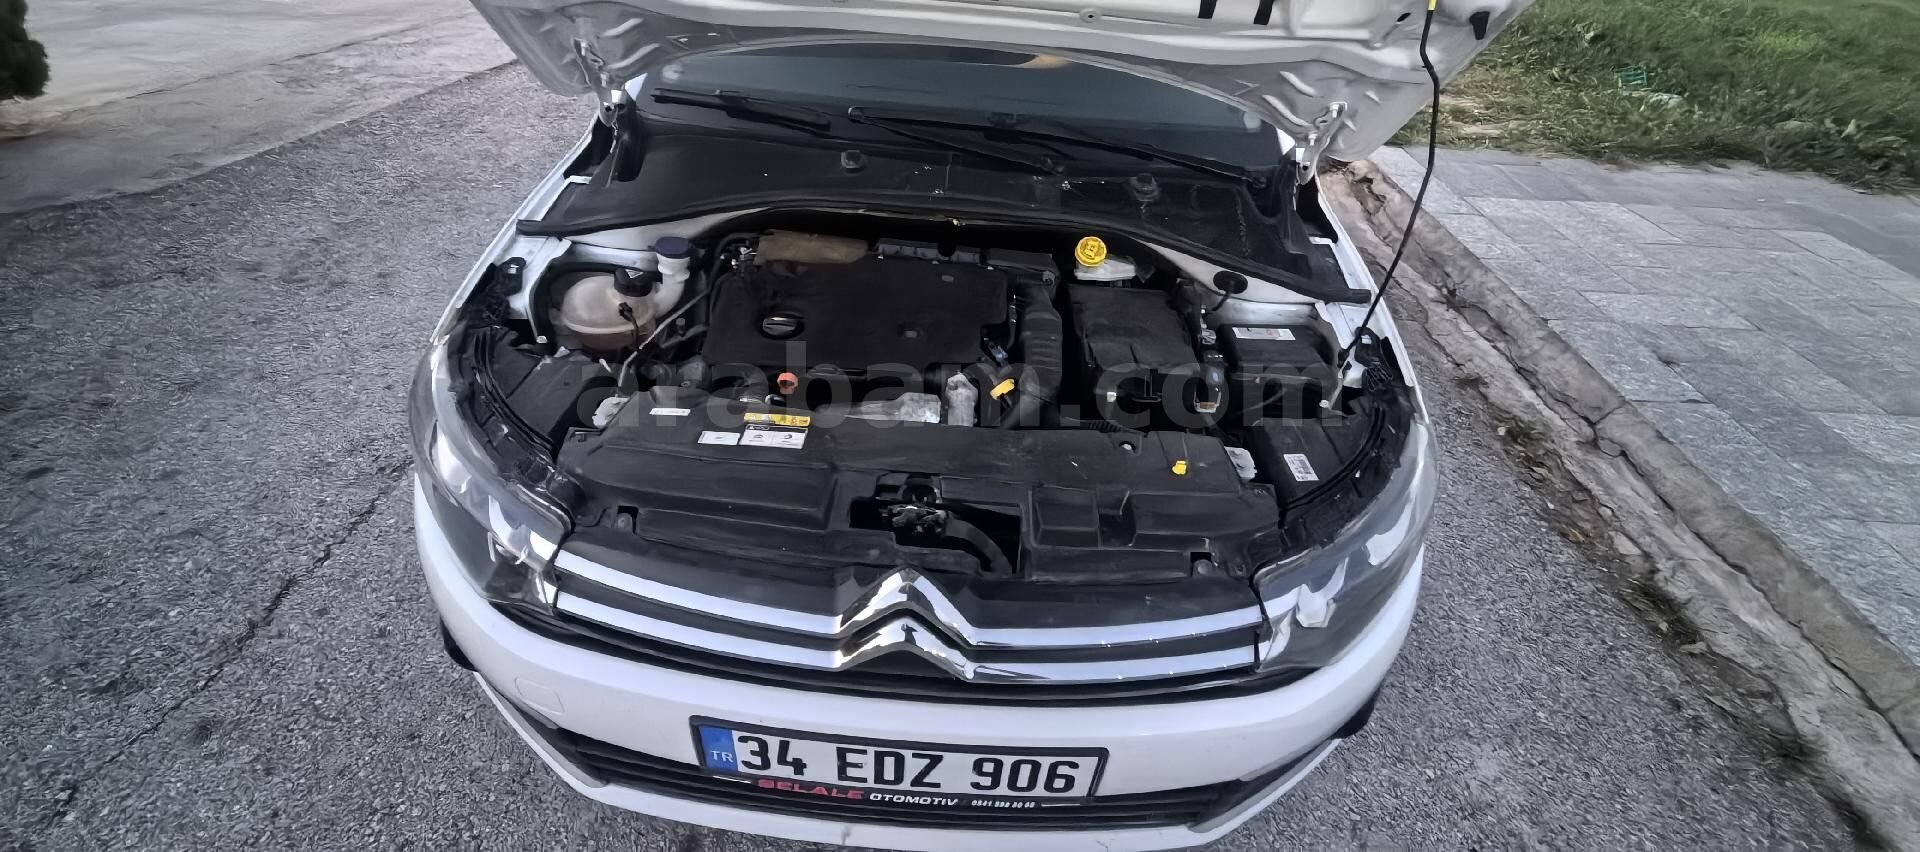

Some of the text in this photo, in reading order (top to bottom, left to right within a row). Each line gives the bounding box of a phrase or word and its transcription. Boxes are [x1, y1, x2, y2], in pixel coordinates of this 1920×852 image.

[711, 750, 734, 764] TR
[737, 735, 1080, 793] 34 EDZ 906
[869, 792, 958, 806] OTOMOTIV
